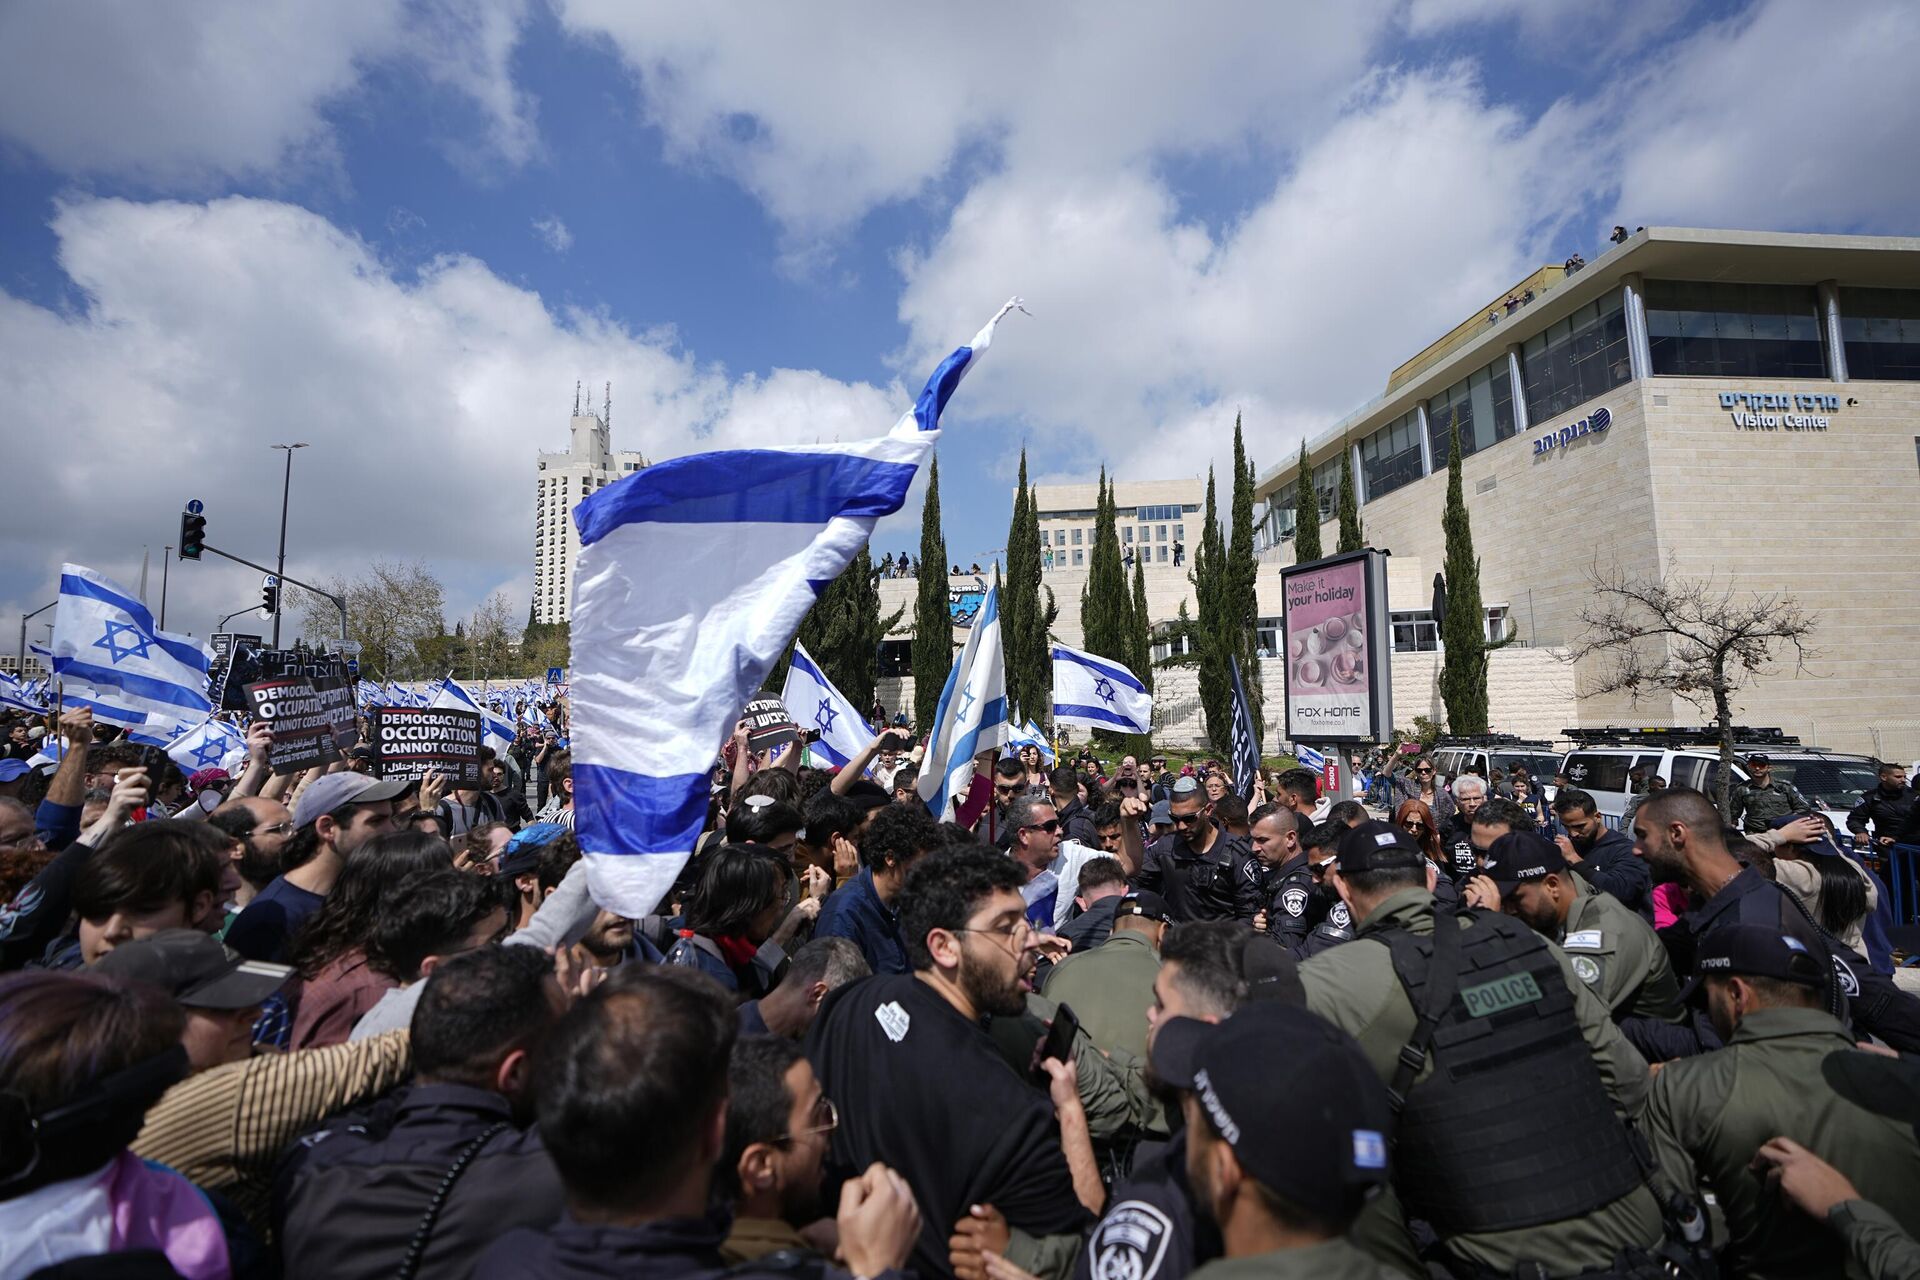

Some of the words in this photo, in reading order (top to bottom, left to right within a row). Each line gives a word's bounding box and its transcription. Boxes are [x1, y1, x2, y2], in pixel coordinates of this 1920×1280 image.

[1718, 392, 1791, 411] מבקרים
[1794, 393, 1840, 409] מרכז
[1732, 412, 1780, 428] Visitor
[1783, 413, 1831, 428] Center
[1560, 420, 1591, 448] בנק
[1534, 432, 1559, 455] יהב
[1288, 580, 1316, 595] Make
[1317, 577, 1325, 589] it
[1288, 595, 1312, 611] your
[1315, 586, 1355, 604] holiday
[744, 699, 784, 713] דמוקרטי
[1297, 707, 1321, 717] FOX
[1324, 706, 1360, 717] HOME
[381, 714, 457, 726] DEMOCRACY
[458, 717, 476, 729] AND
[381, 726, 477, 743] OCCUPATION
[381, 742, 439, 754] CANNOT
[441, 743, 478, 755] COEXIST
[382, 773, 407, 782] כיבוש
[408, 773, 421, 781] עם
[1517, 866, 1546, 878] משטרה
[1701, 957, 1730, 969] משטרה
[1467, 976, 1538, 1013] POLICE
